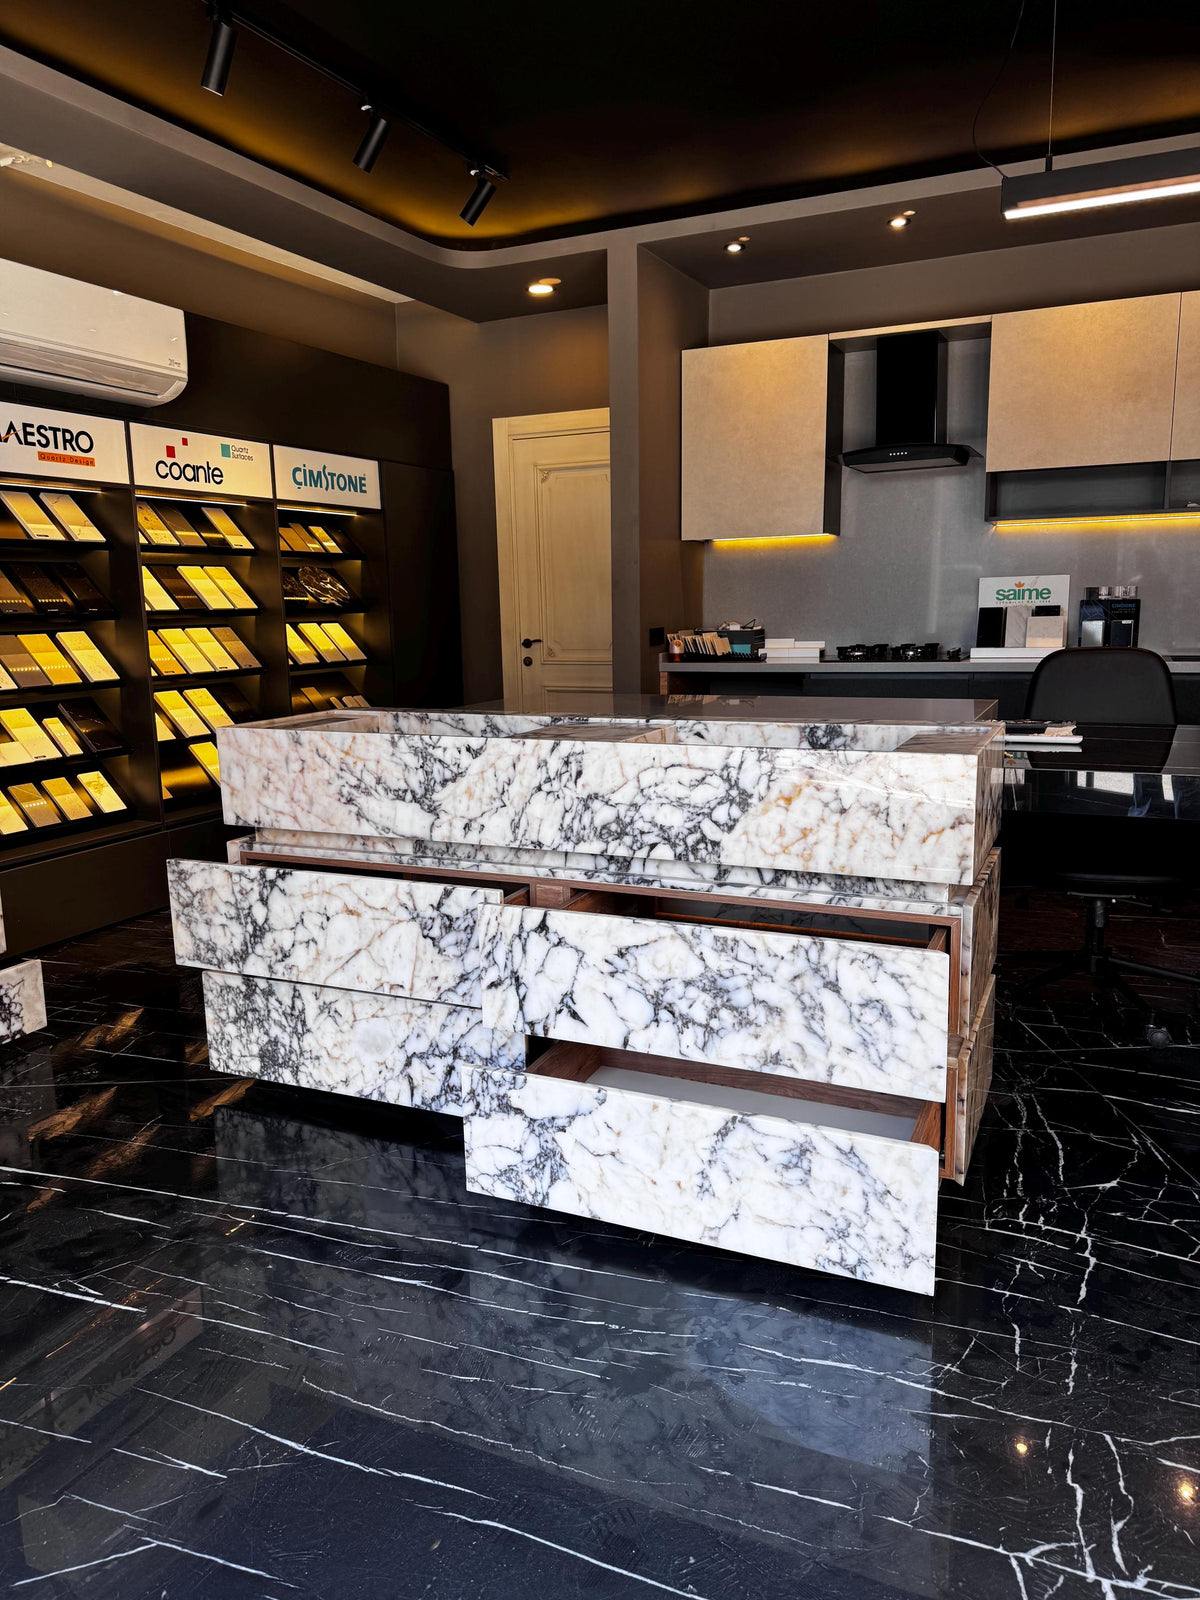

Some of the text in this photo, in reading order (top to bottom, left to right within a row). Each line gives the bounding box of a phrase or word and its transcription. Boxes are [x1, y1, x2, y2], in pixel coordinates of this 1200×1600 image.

[0, 420, 94, 453] AESTRO
[231, 444, 249, 454] Quartz
[40, 453, 94, 466] Quartz Design
[231, 451, 254, 461] Surfaces
[155, 460, 224, 485] coante
[995, 587, 1052, 601] saime
